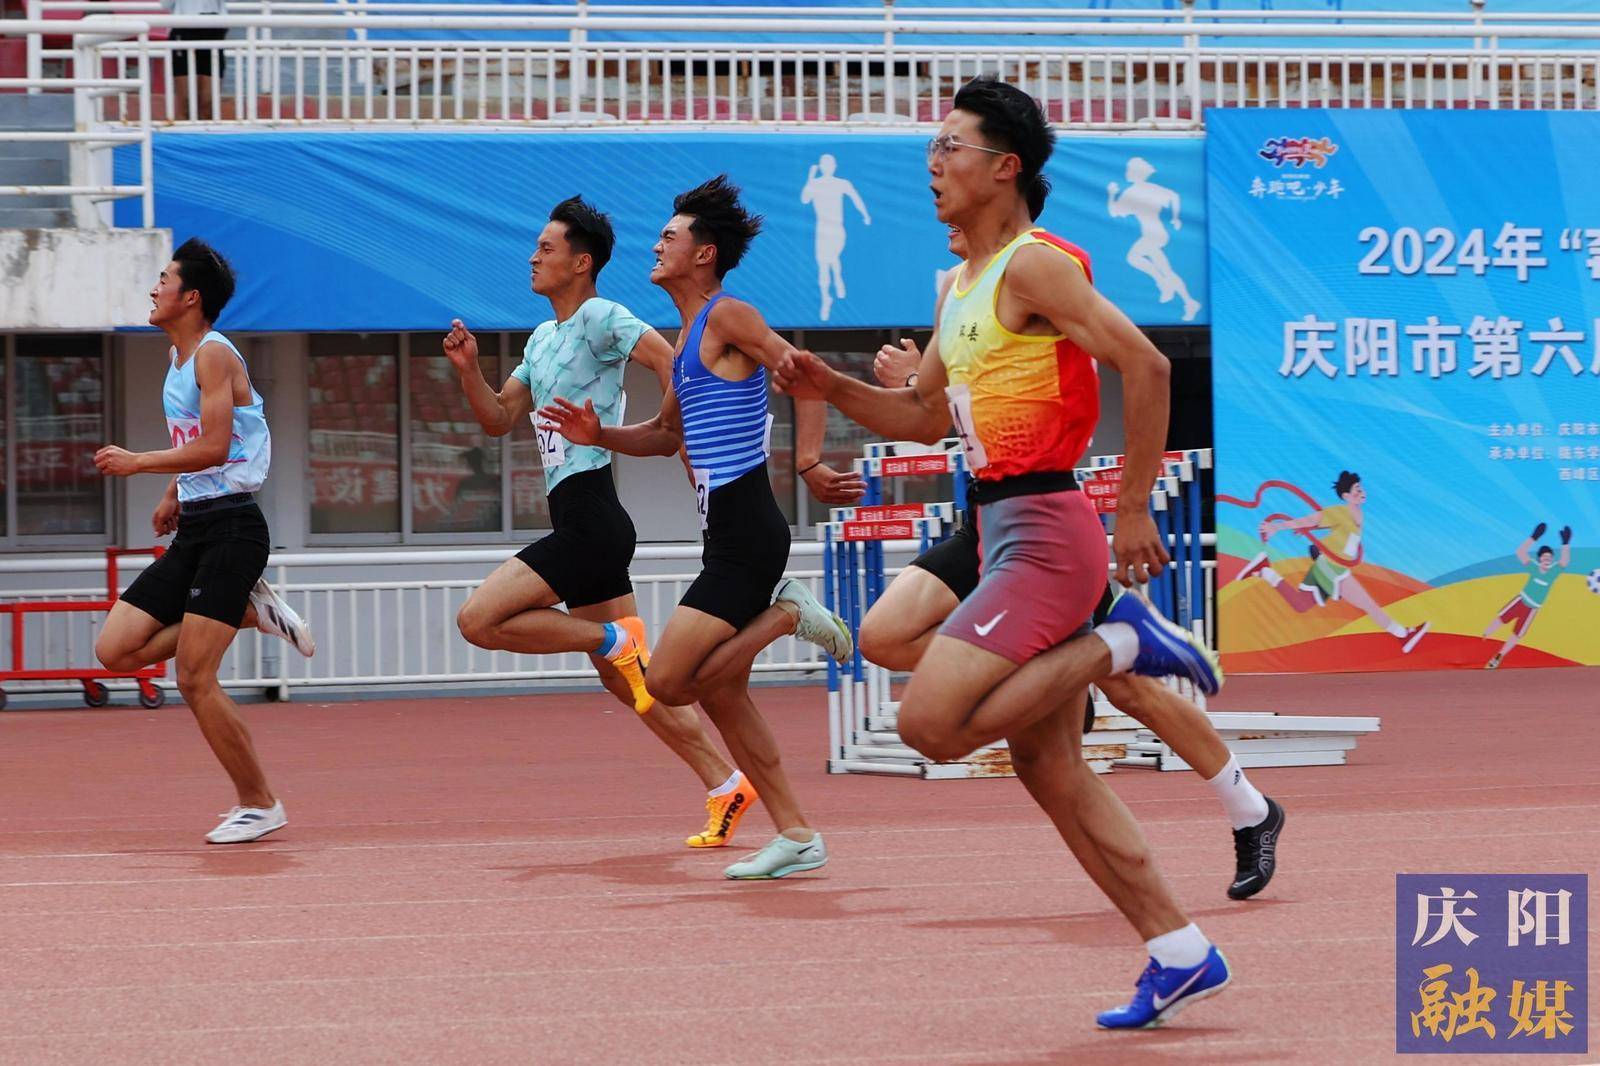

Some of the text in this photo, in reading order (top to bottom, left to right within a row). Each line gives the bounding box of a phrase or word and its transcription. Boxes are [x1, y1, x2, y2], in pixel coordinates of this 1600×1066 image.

[1357, 222, 1600, 283] 2024年“
[1278, 314, 1600, 380] 庆阳市第六
